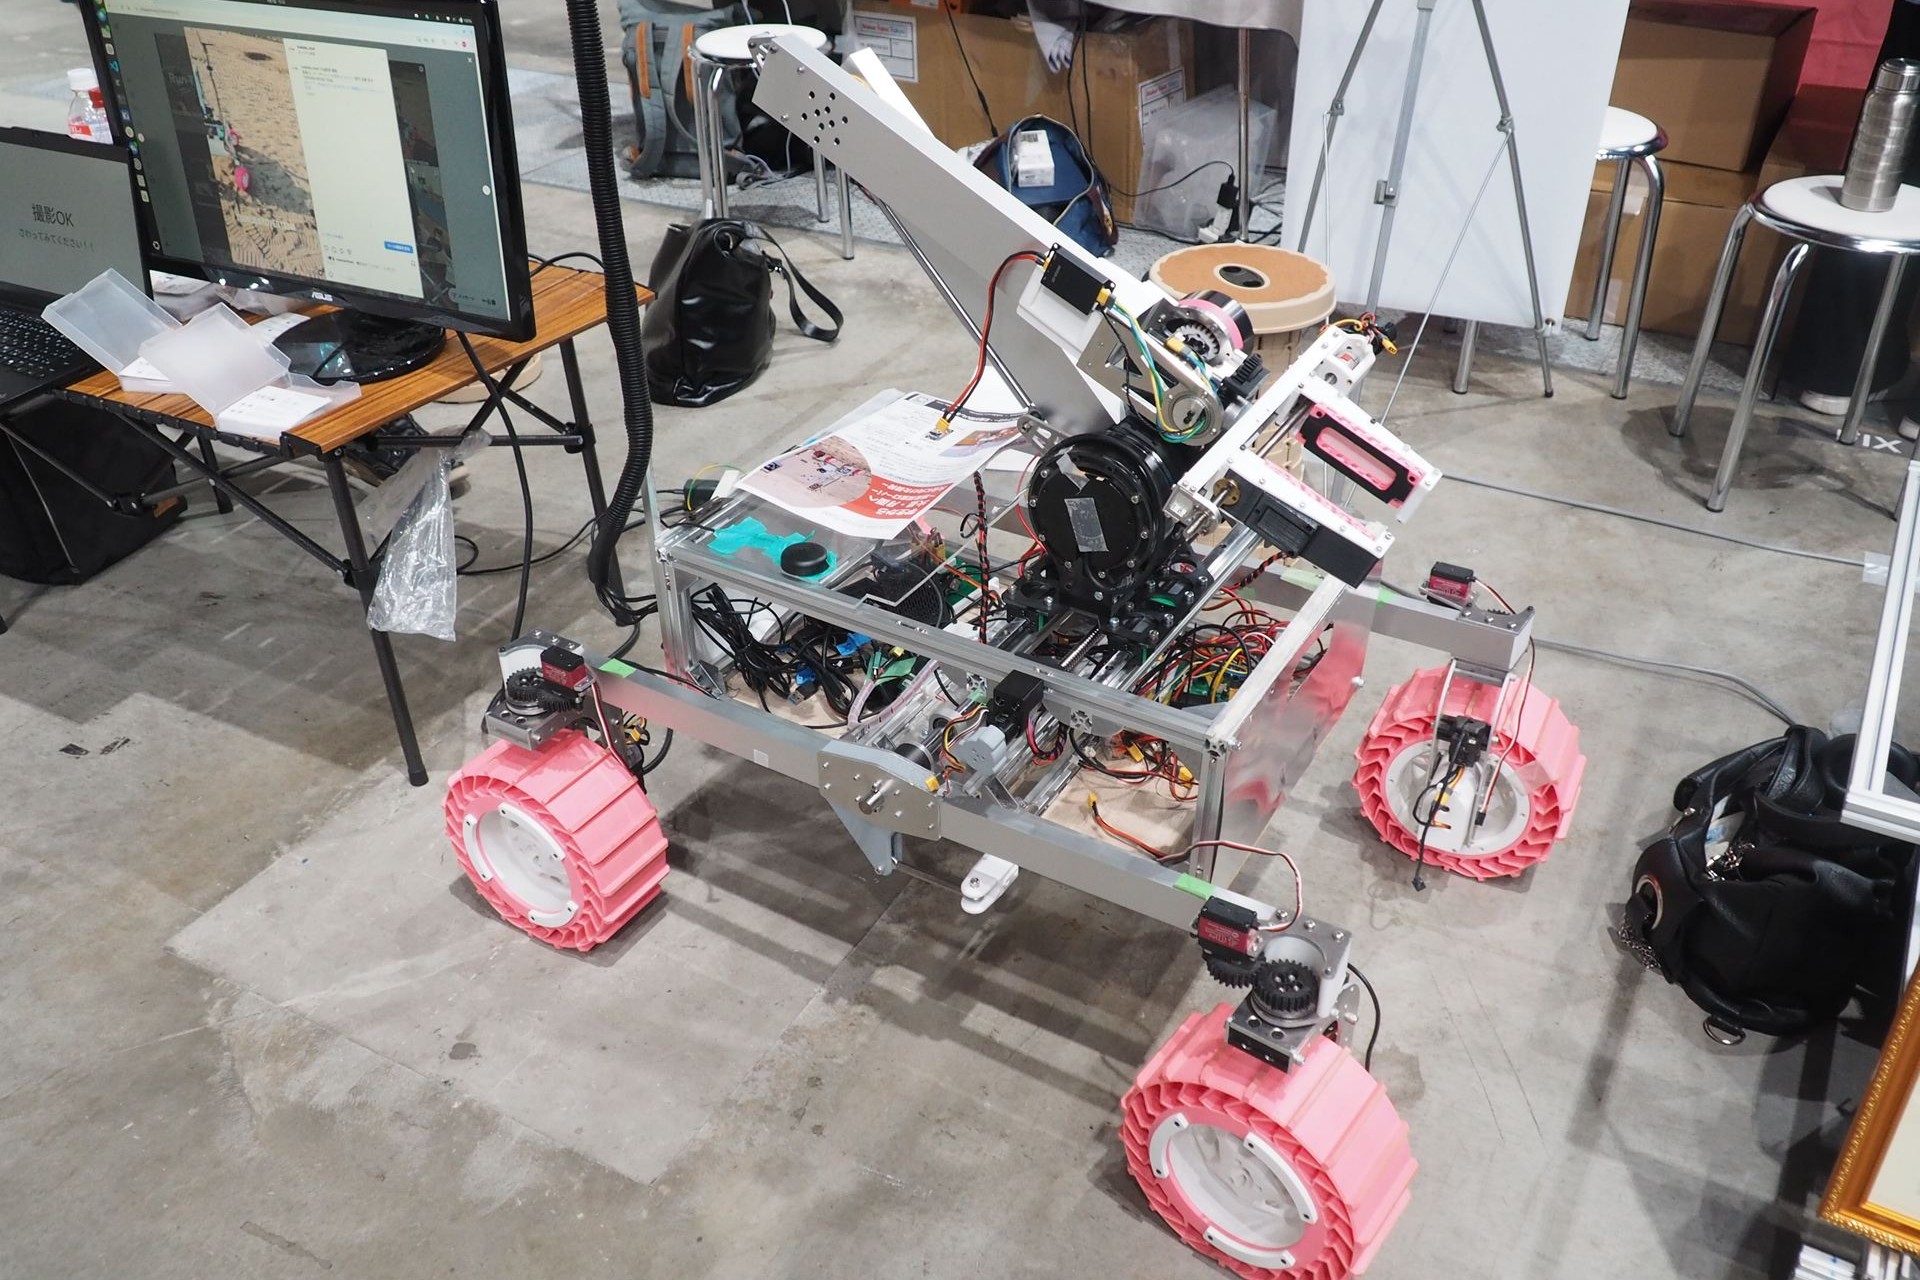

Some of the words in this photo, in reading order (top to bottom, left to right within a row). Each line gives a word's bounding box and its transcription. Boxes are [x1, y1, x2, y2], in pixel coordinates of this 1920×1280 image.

[32, 203, 74, 227] 撮影OK
[311, 291, 333, 301] ASUS
[1836, 428, 1902, 454] IX
